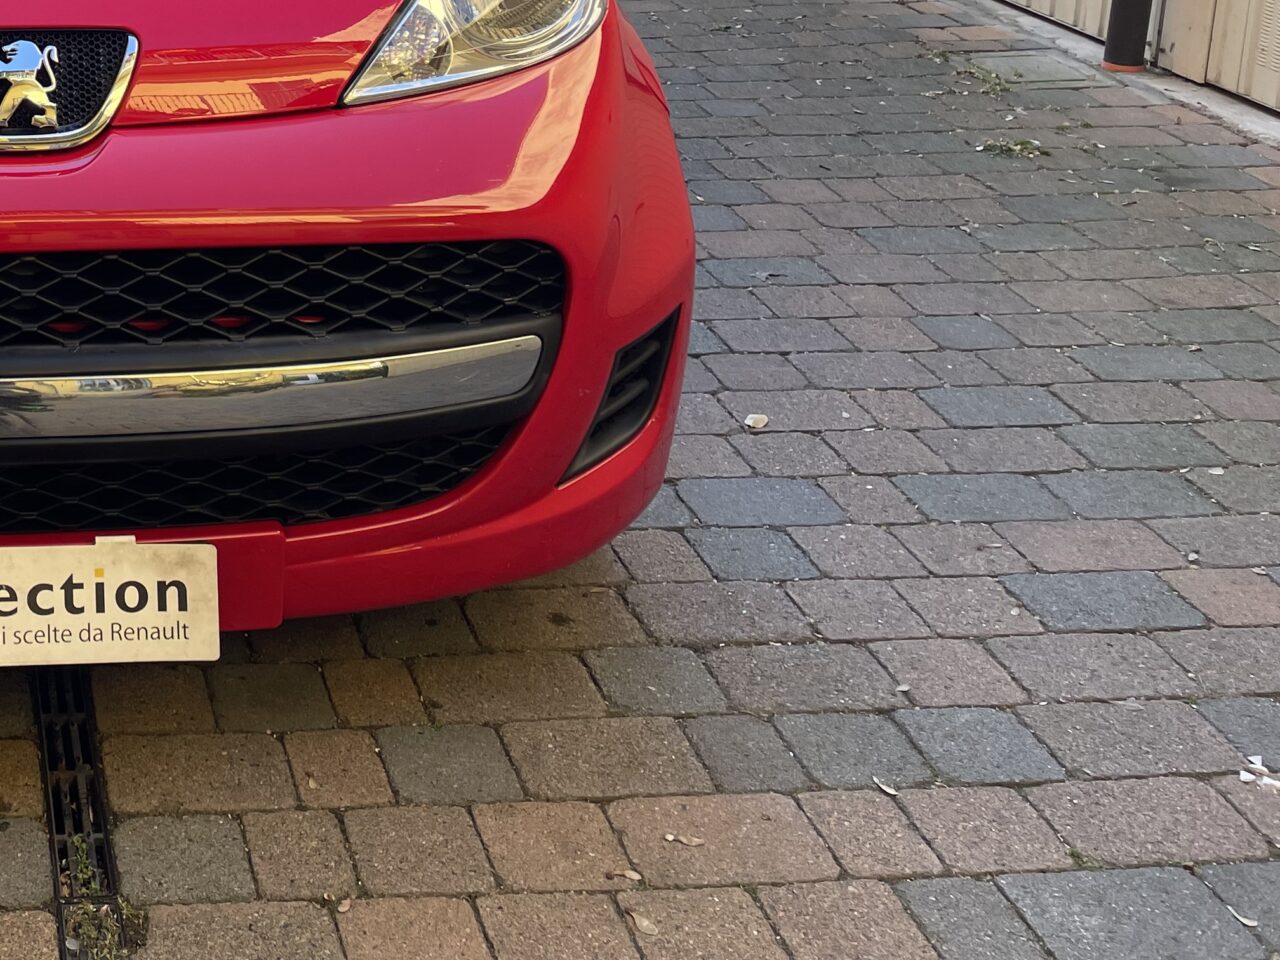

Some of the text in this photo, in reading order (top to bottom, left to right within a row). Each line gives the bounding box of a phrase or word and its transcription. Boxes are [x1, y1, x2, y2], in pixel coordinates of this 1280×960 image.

[13, 624, 72, 644] scelte
[78, 622, 103, 643] da
[111, 620, 189, 641] Renault
